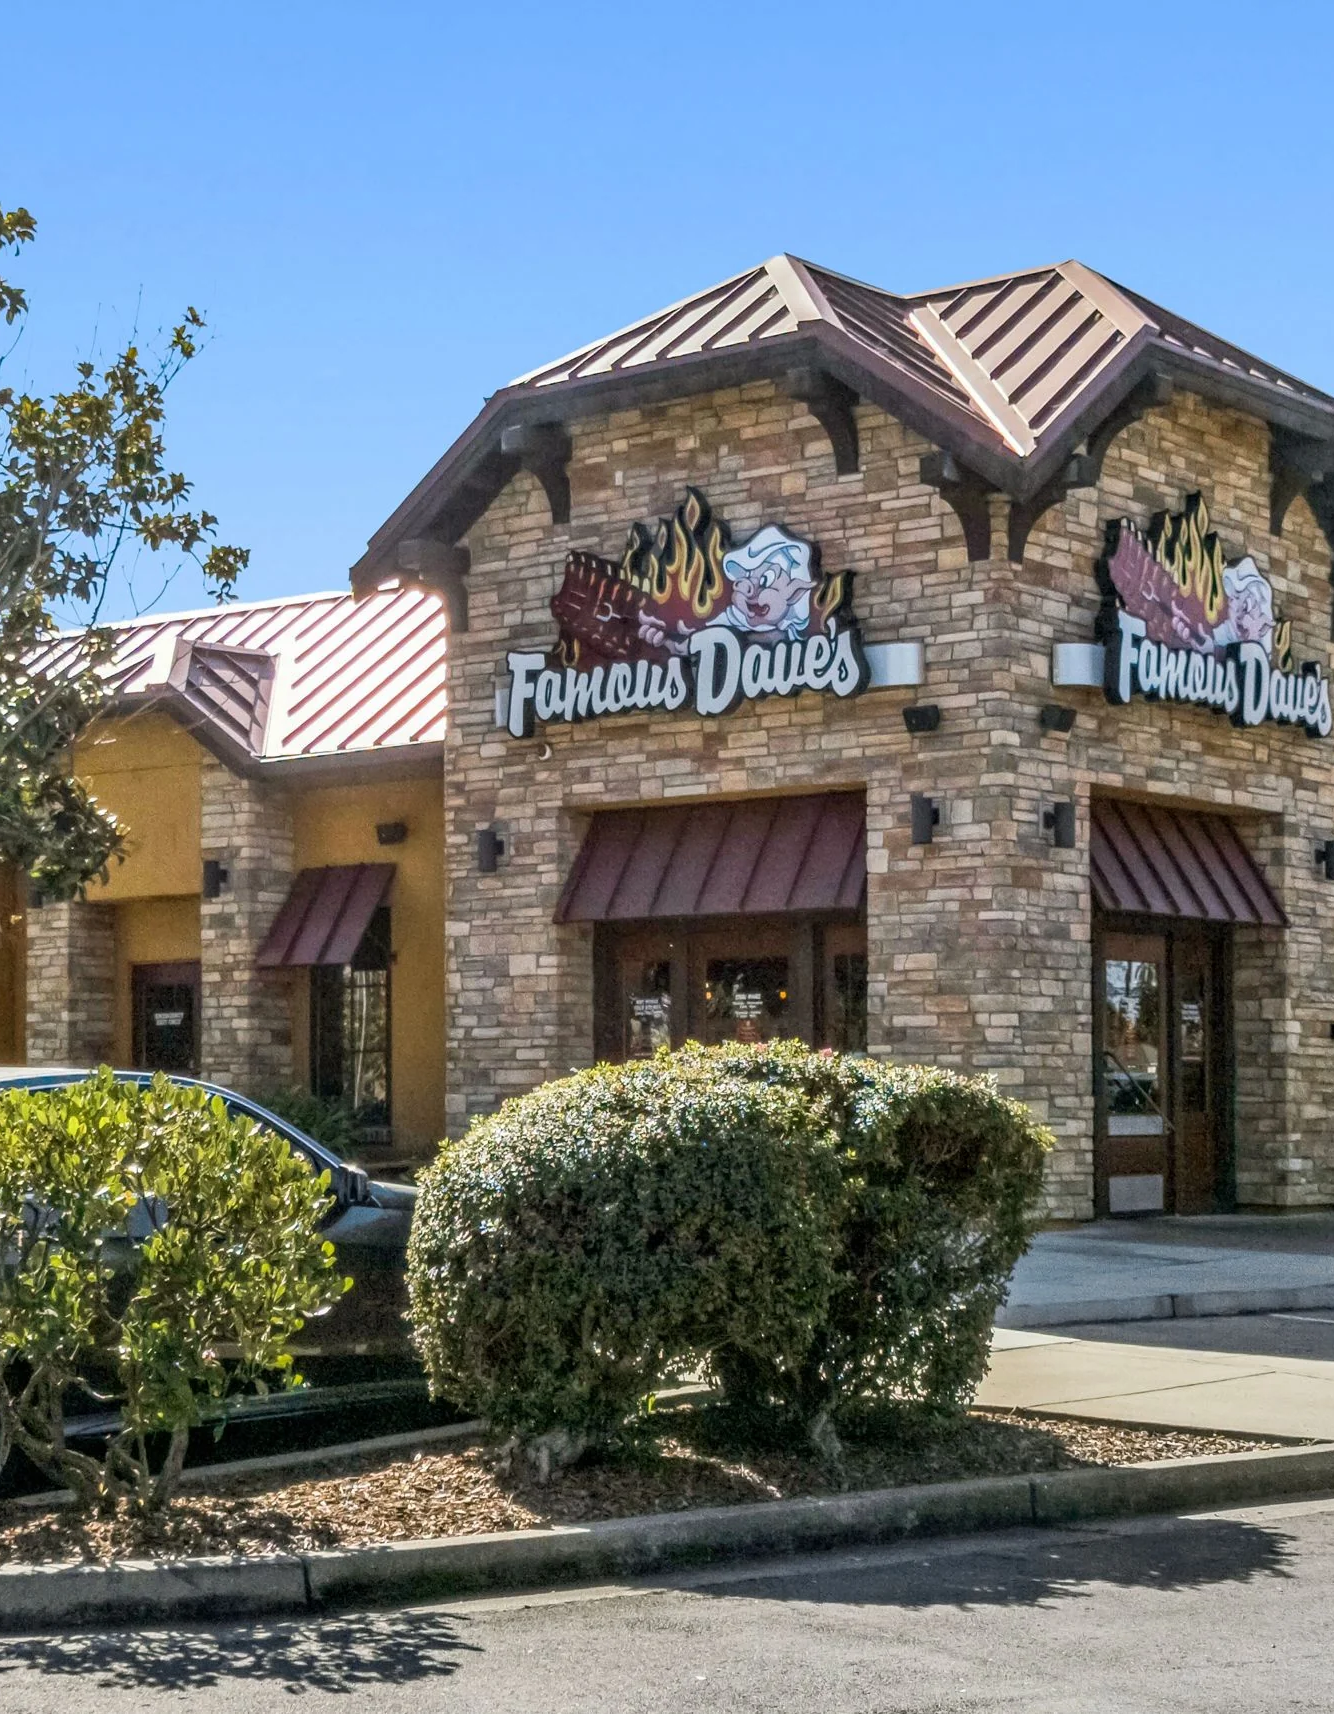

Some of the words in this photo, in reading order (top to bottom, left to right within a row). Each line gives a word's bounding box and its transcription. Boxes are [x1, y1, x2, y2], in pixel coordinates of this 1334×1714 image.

[509, 652, 686, 737] Famous
[689, 618, 860, 716] Dave's
[1118, 610, 1239, 713] Famous
[1240, 641, 1333, 737] Dave's
